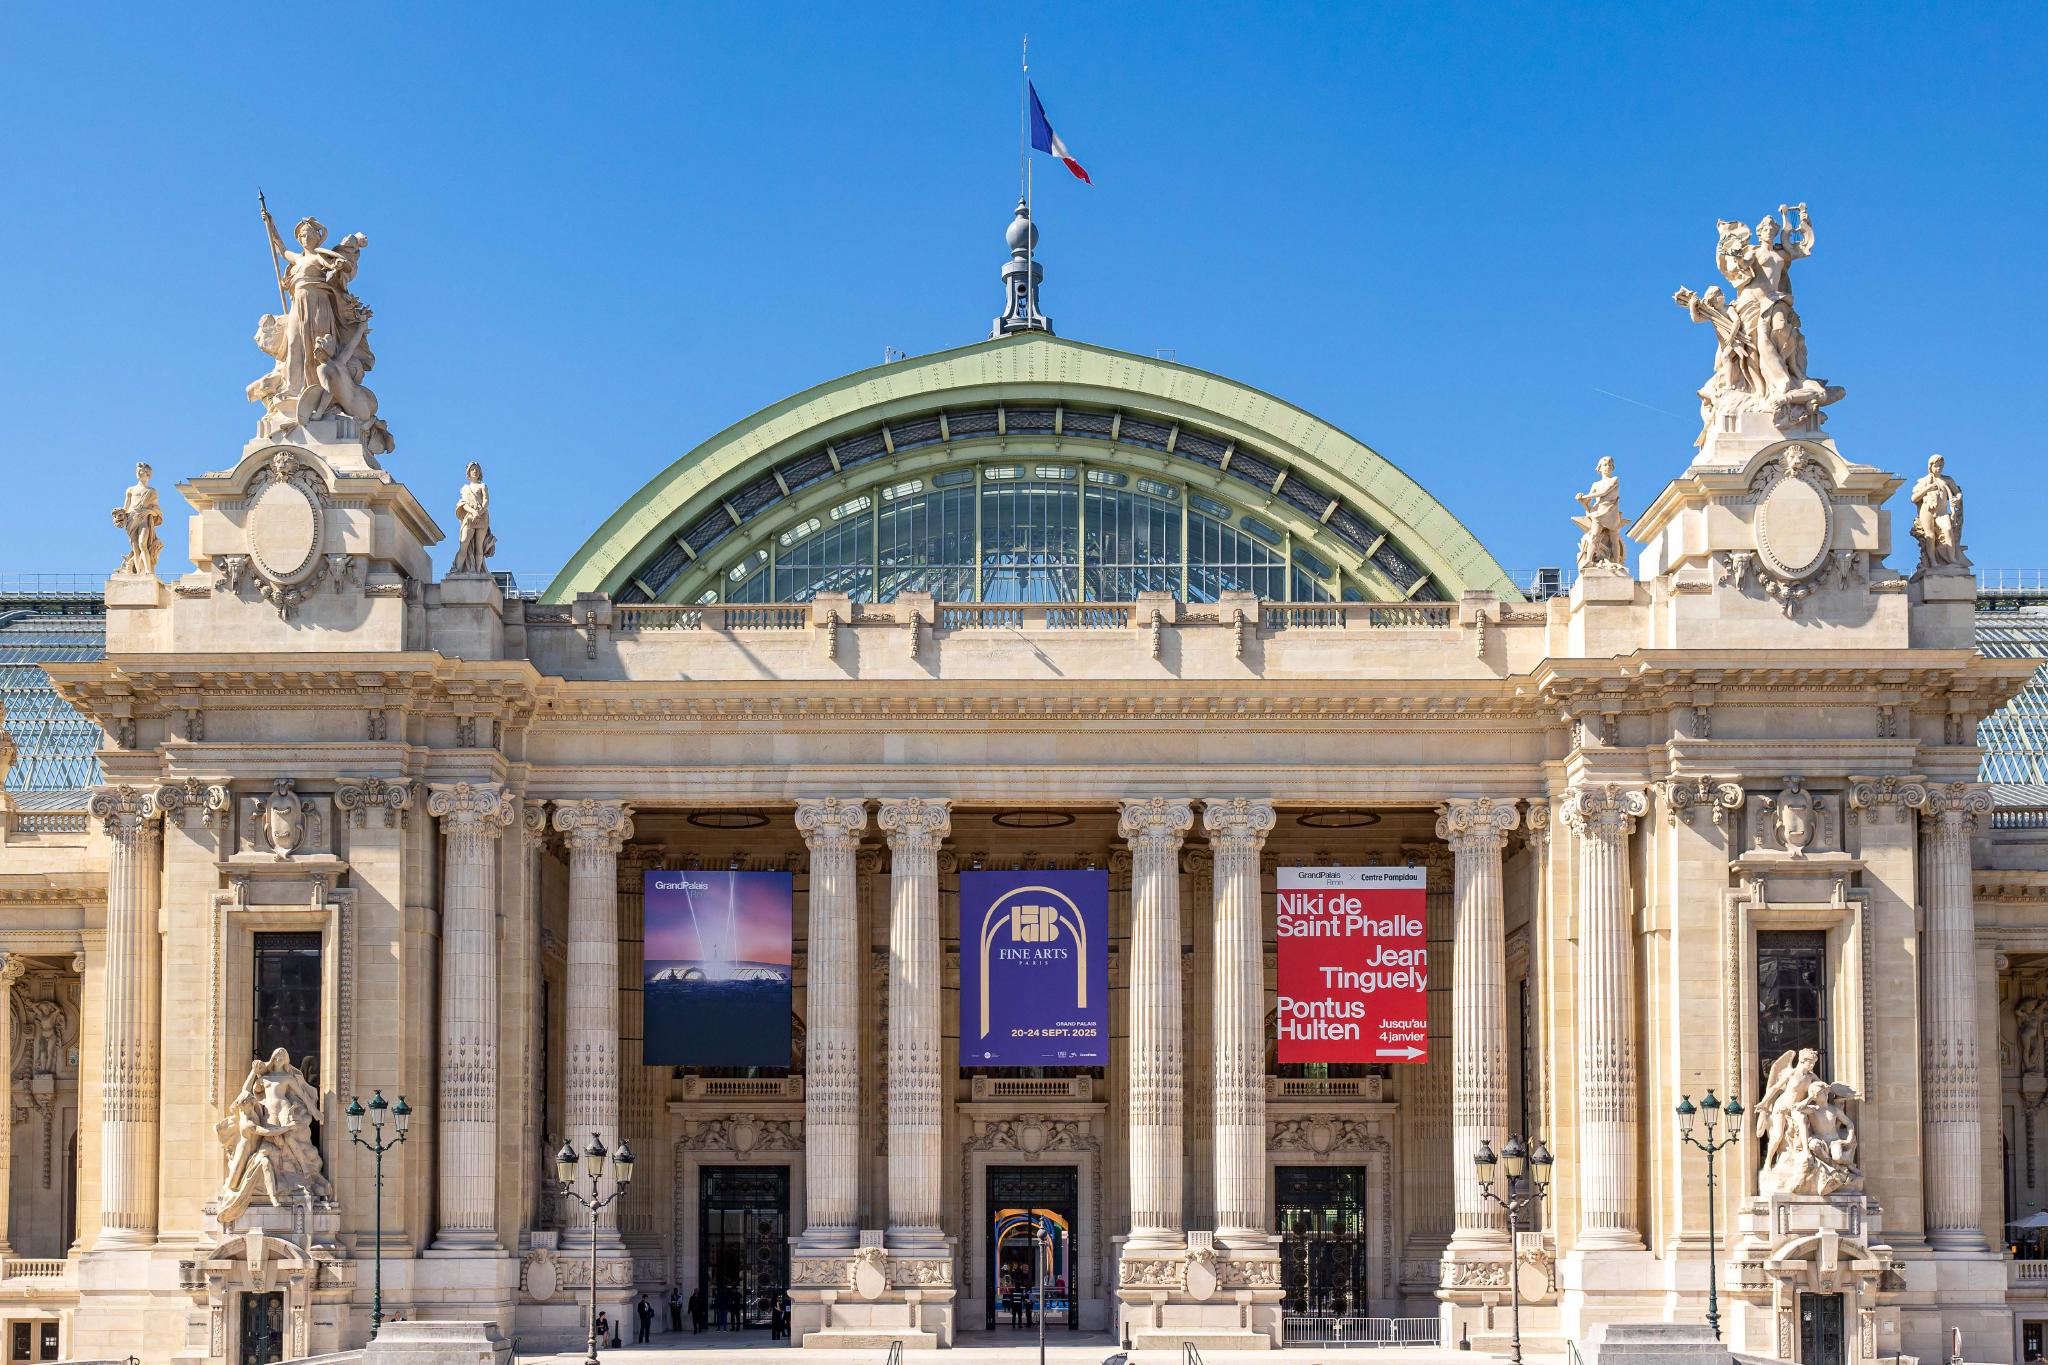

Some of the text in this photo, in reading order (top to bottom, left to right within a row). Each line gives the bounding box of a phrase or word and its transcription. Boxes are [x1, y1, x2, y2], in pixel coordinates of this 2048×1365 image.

[1298, 871, 1341, 879] GrandPalais
[1361, 873, 1418, 882] Centre Pompidou
[655, 881, 709, 890] GrandPalais
[1277, 893, 1362, 915] Niki de
[1277, 915, 1423, 937] Saint Phalle
[999, 948, 1068, 960] FINE ARTS
[1366, 944, 1427, 967] Jean
[1320, 966, 1427, 993] Tinguely
[1278, 996, 1366, 1018] Pontus
[1011, 1028, 1097, 1037] 20-24 SEPT. 2025
[1278, 1018, 1360, 1040] Hulten
[1378, 1031, 1425, 1043] 4 janvier
